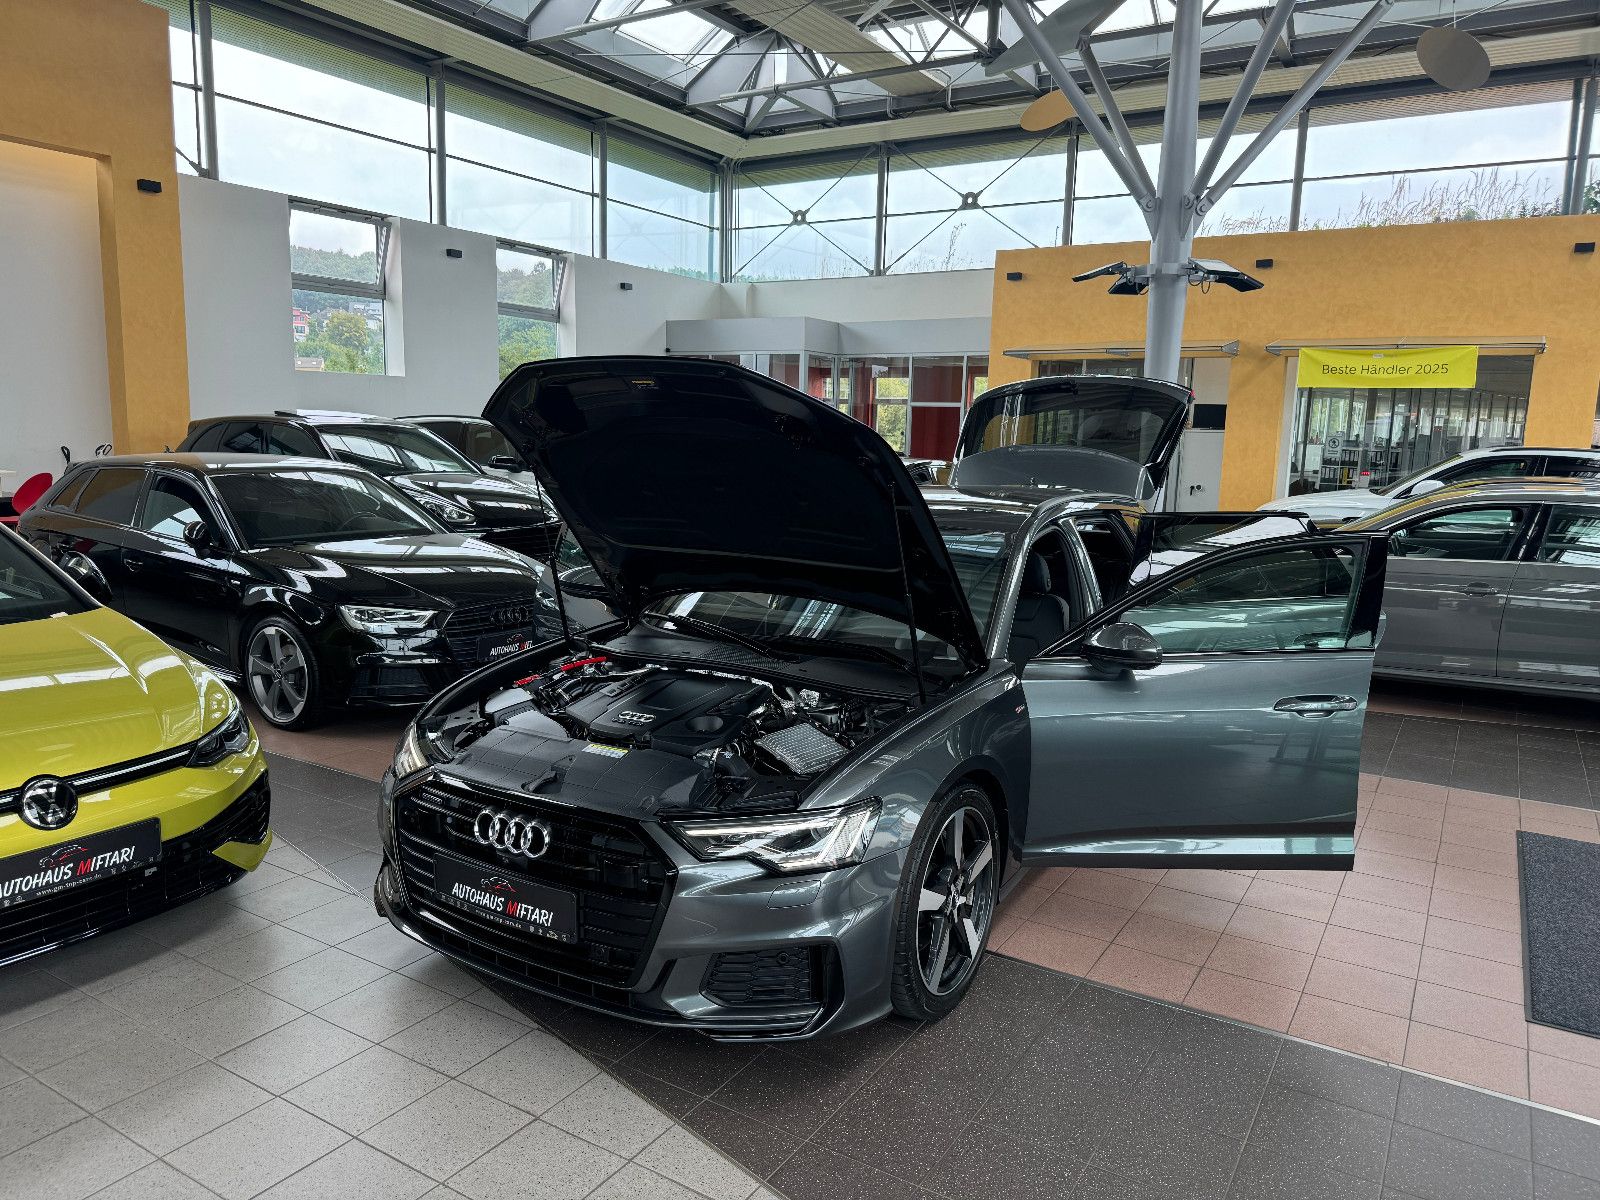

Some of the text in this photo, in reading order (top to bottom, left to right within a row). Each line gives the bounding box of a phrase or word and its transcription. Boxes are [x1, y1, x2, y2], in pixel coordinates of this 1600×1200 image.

[1322, 363, 1449, 375] Beste Händler 2025
[490, 643, 520, 656] AUTOHAUS
[77, 846, 136, 876] MIFTARI
[452, 882, 505, 912] AUTOHAUS
[506, 900, 554, 927] MIFTARI
